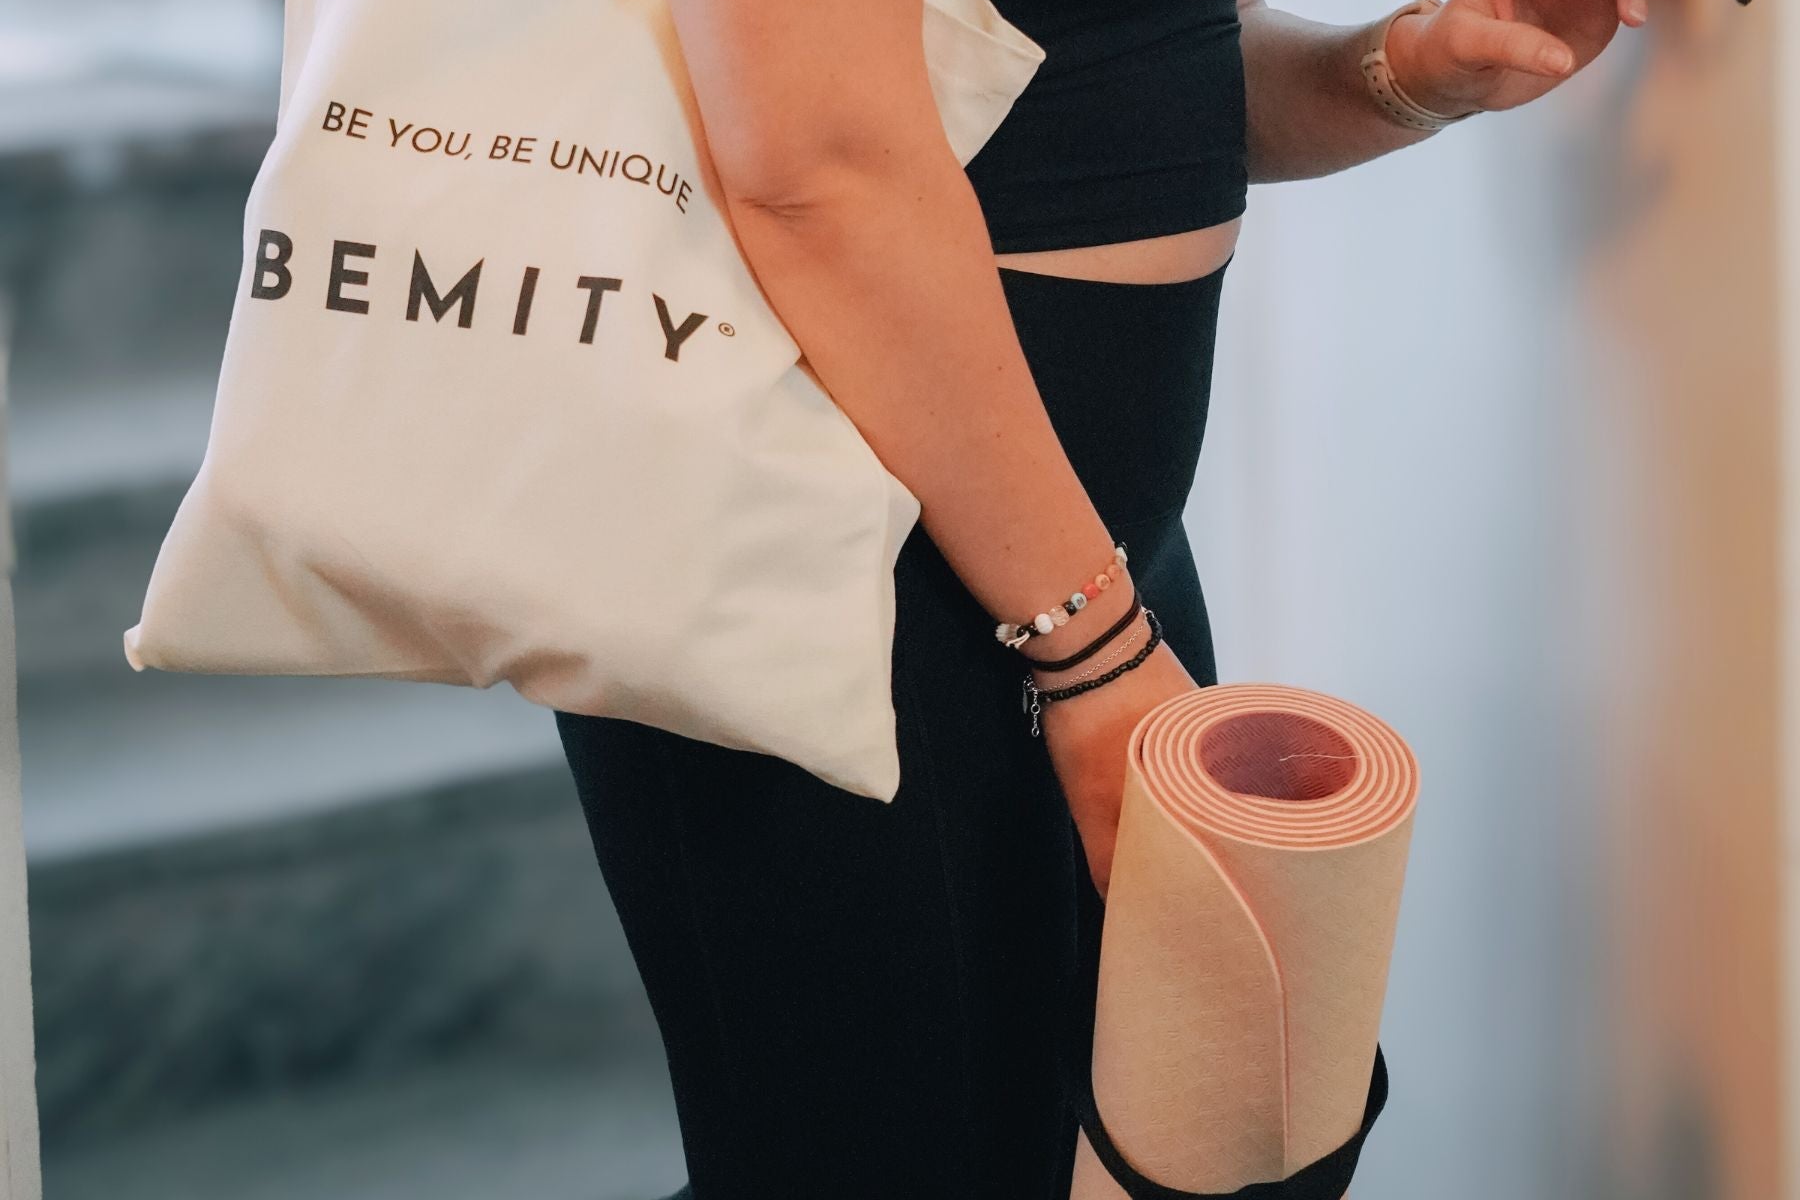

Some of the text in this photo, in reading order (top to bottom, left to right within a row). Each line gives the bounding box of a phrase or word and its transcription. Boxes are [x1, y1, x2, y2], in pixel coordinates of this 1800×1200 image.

[322, 100, 693, 215] BE YOU, BE UNIQUE
